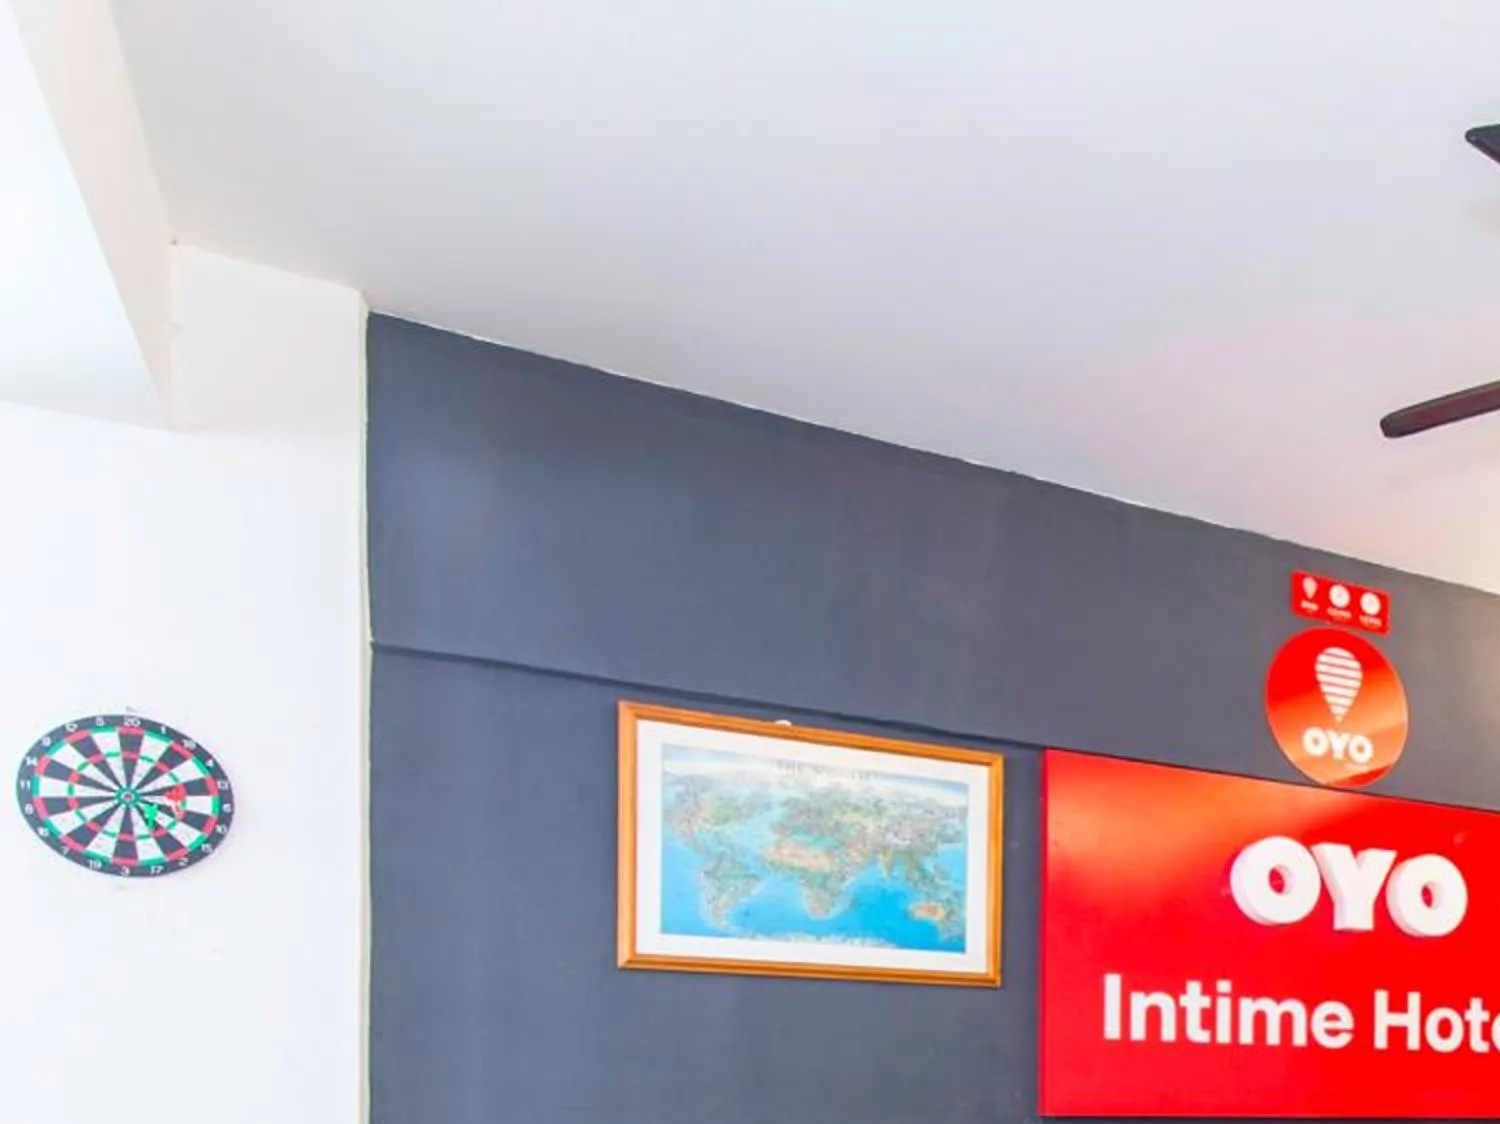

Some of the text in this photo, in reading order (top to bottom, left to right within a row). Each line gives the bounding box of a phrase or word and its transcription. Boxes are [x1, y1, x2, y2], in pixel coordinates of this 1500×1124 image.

[123, 717, 140, 727] 20
[161, 725, 167, 735] 1
[1303, 727, 1373, 763] OYO
[20, 780, 31, 790] 11
[150, 866, 164, 875] 17
[1229, 835, 1468, 938] OYO
[1103, 973, 1354, 1048] Intime
